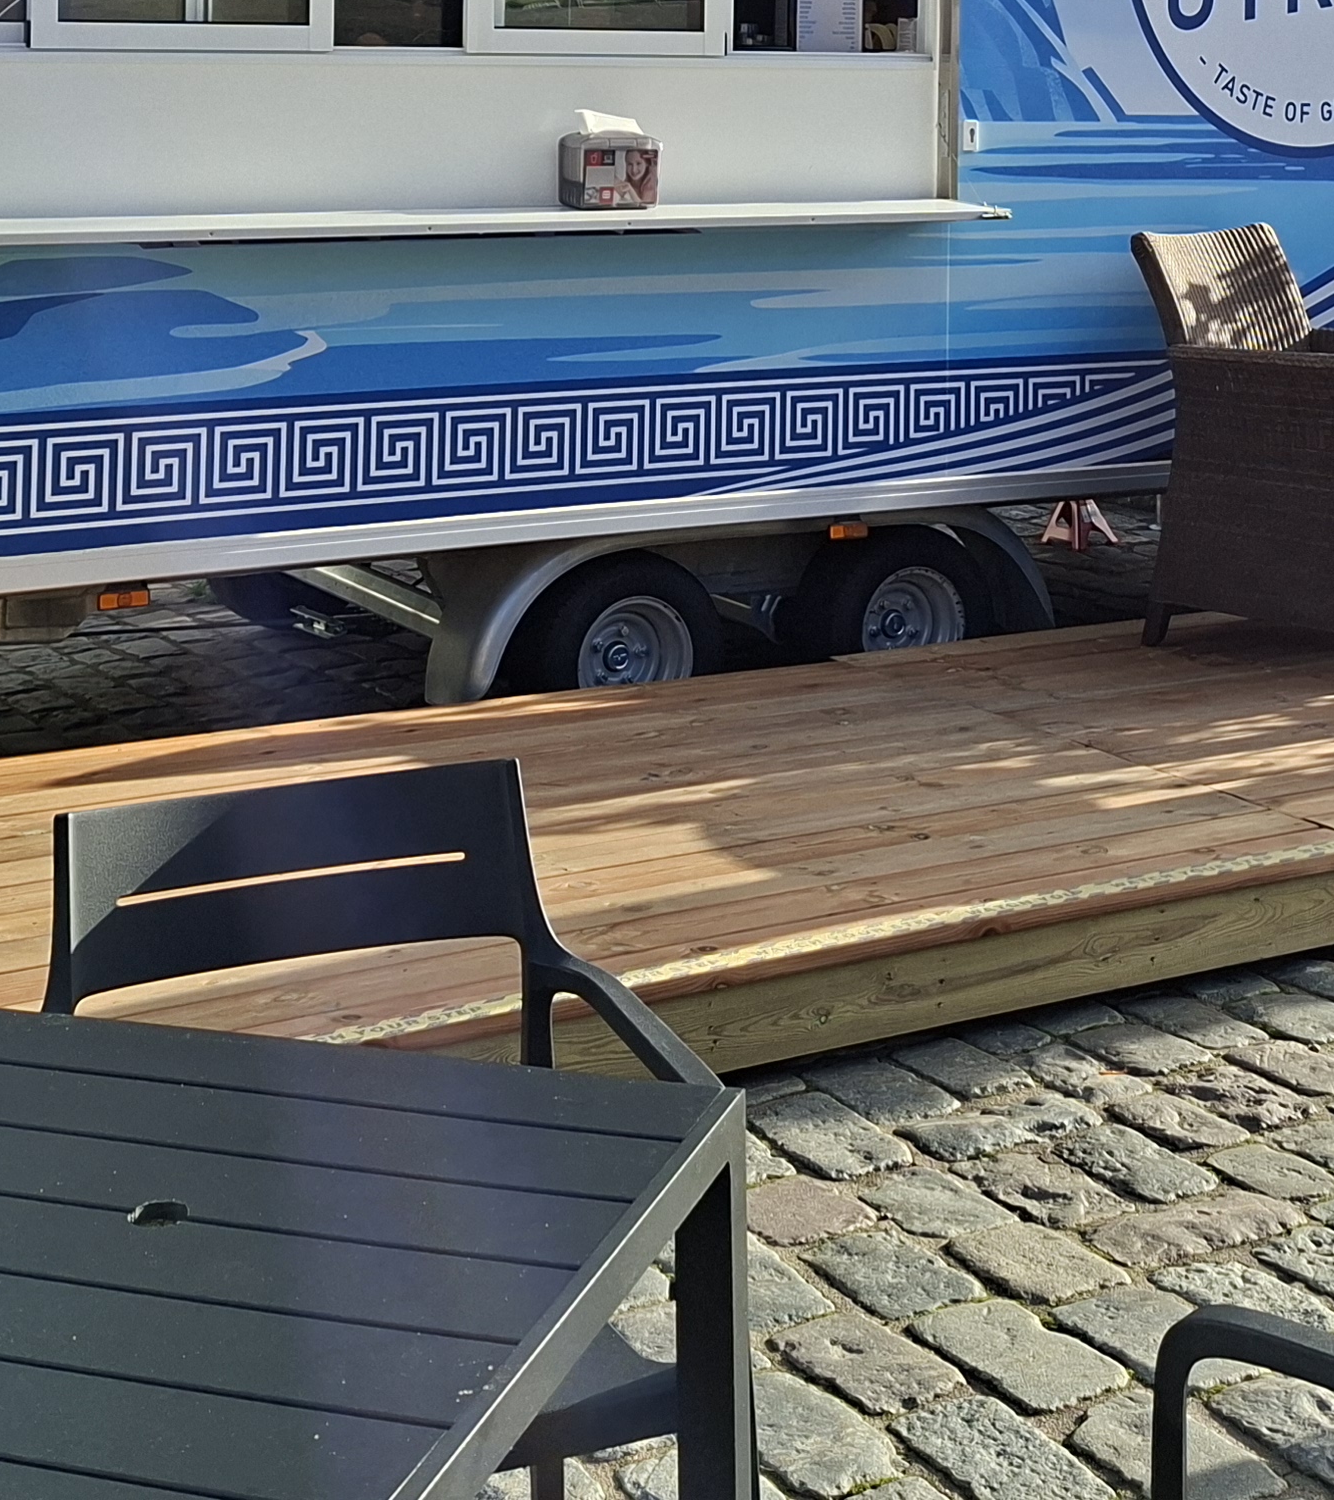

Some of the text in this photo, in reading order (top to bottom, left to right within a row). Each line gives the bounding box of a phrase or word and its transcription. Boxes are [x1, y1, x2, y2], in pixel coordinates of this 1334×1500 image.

[1213, 62, 1276, 118] TASTE
[1284, 101, 1311, 123] OF
[352, 1018, 419, 1037] YOUR
[426, 1005, 483, 1021] STEP
